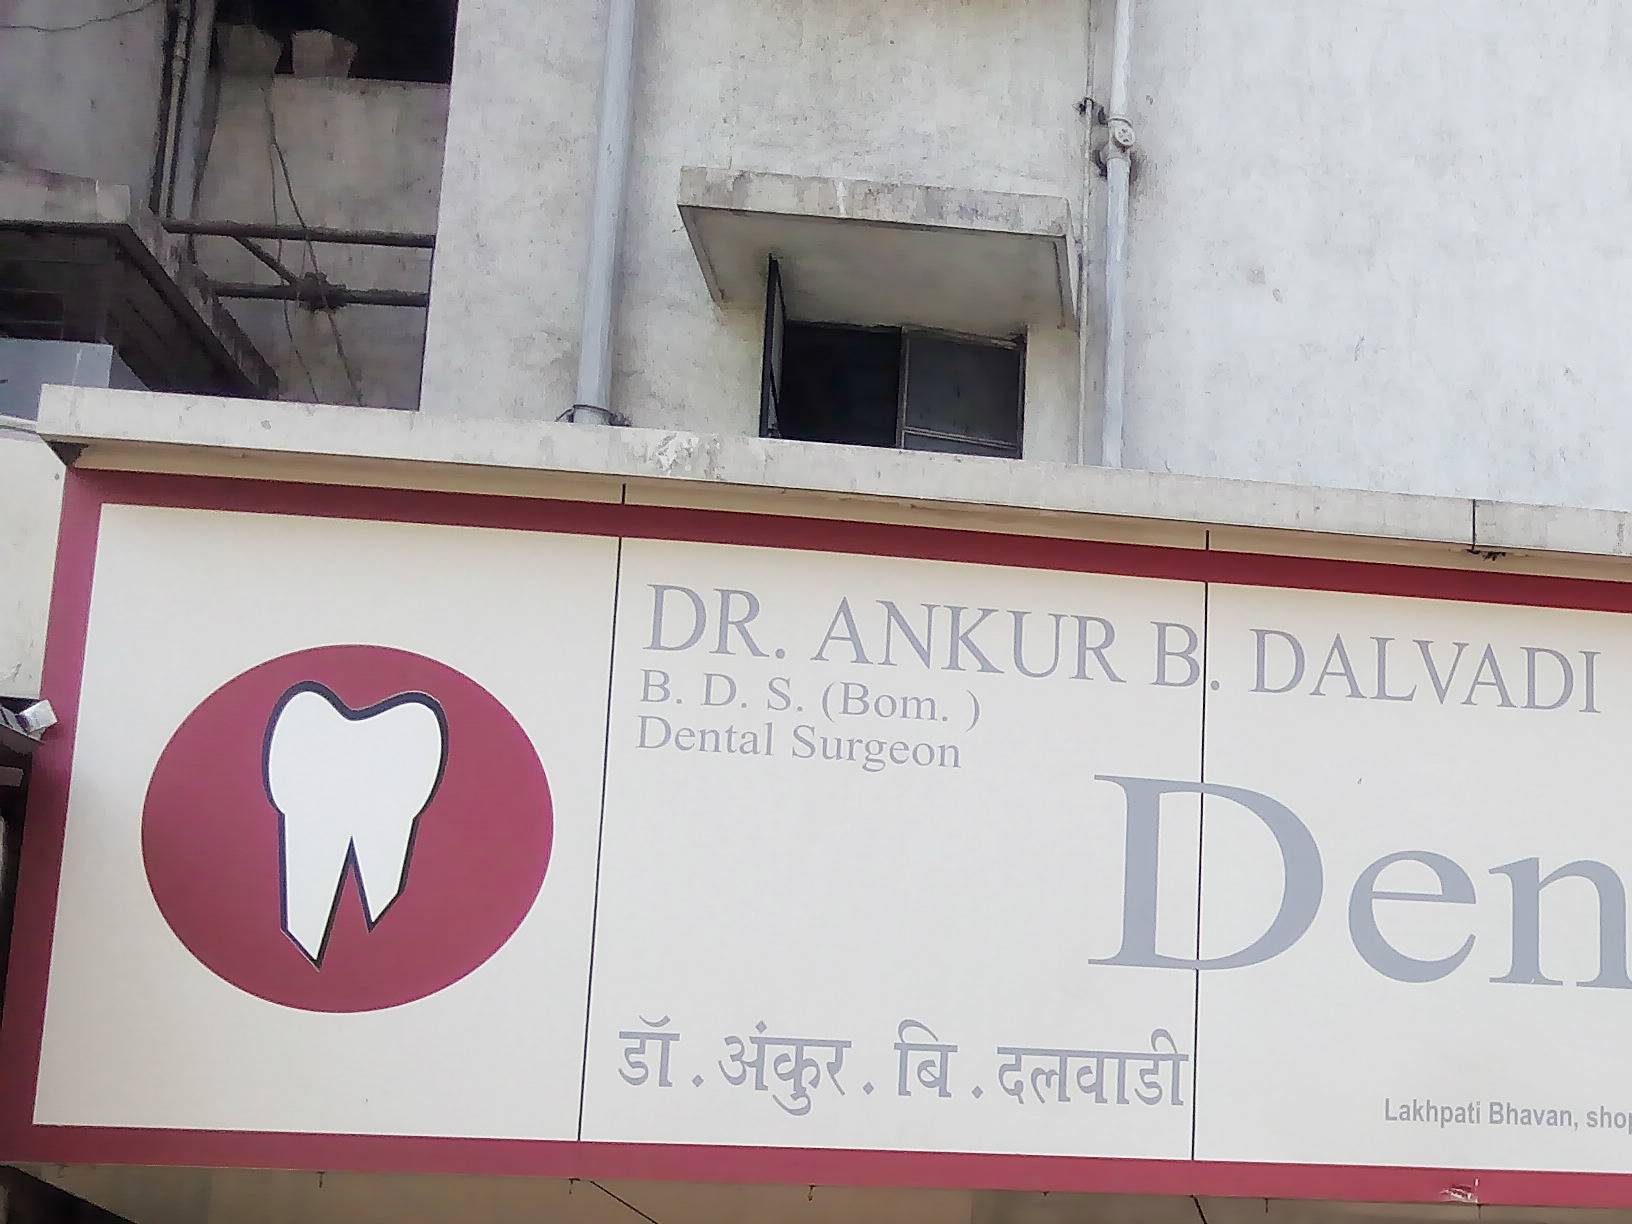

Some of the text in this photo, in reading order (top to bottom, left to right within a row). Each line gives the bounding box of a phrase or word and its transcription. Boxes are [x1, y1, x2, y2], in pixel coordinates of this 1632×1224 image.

[642, 583, 1602, 714] DR. ANKUR B. DALVADI
[636, 715, 962, 773] Dental Surgeon
[996, 1028, 1189, 1106] दलवाडी
[1385, 1098, 1480, 1128] Lakhpati
[1489, 1101, 1578, 1131] Bhavan,
